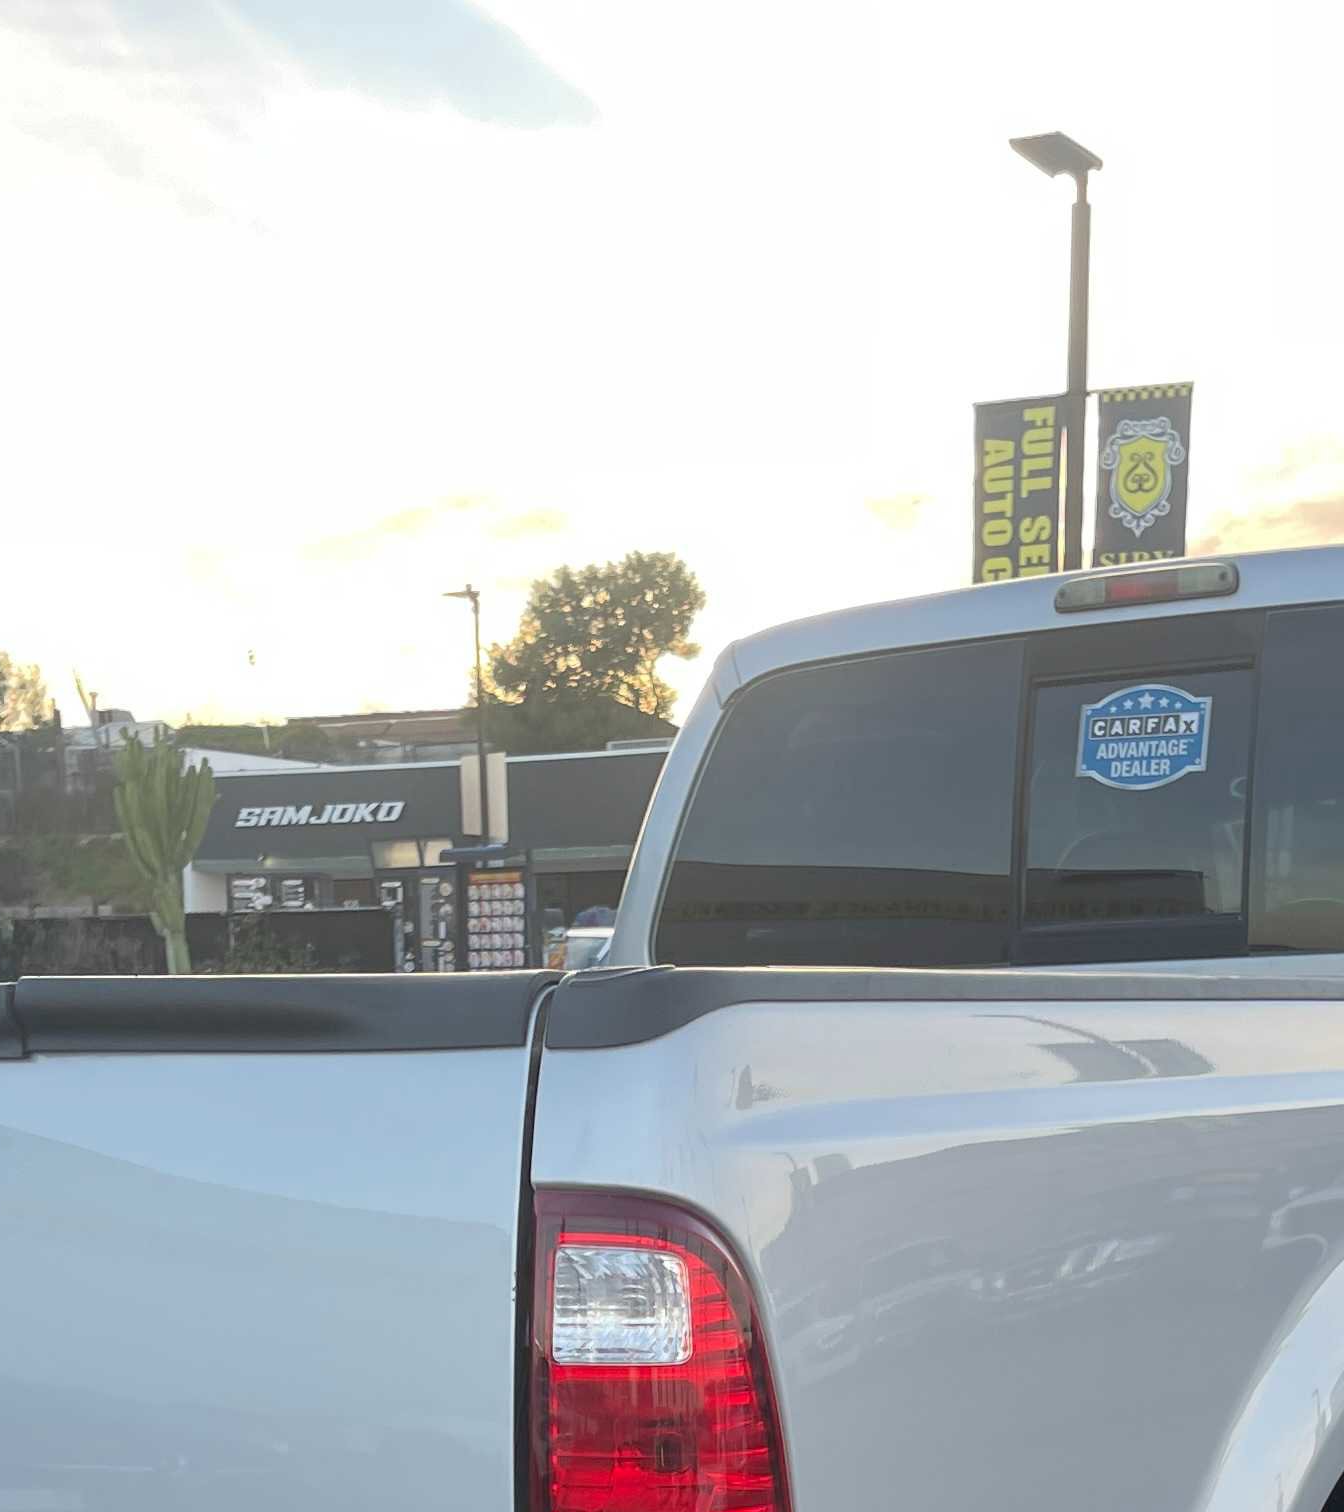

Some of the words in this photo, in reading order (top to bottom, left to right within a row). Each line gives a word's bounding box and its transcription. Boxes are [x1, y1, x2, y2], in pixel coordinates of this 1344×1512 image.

[1021, 406, 1056, 498] FULL
[982, 439, 1015, 547] AUTO
[1092, 714, 1196, 738] CARFAX
[1110, 759, 1171, 778] DEALER
[234, 801, 405, 828] SAMJOKO
